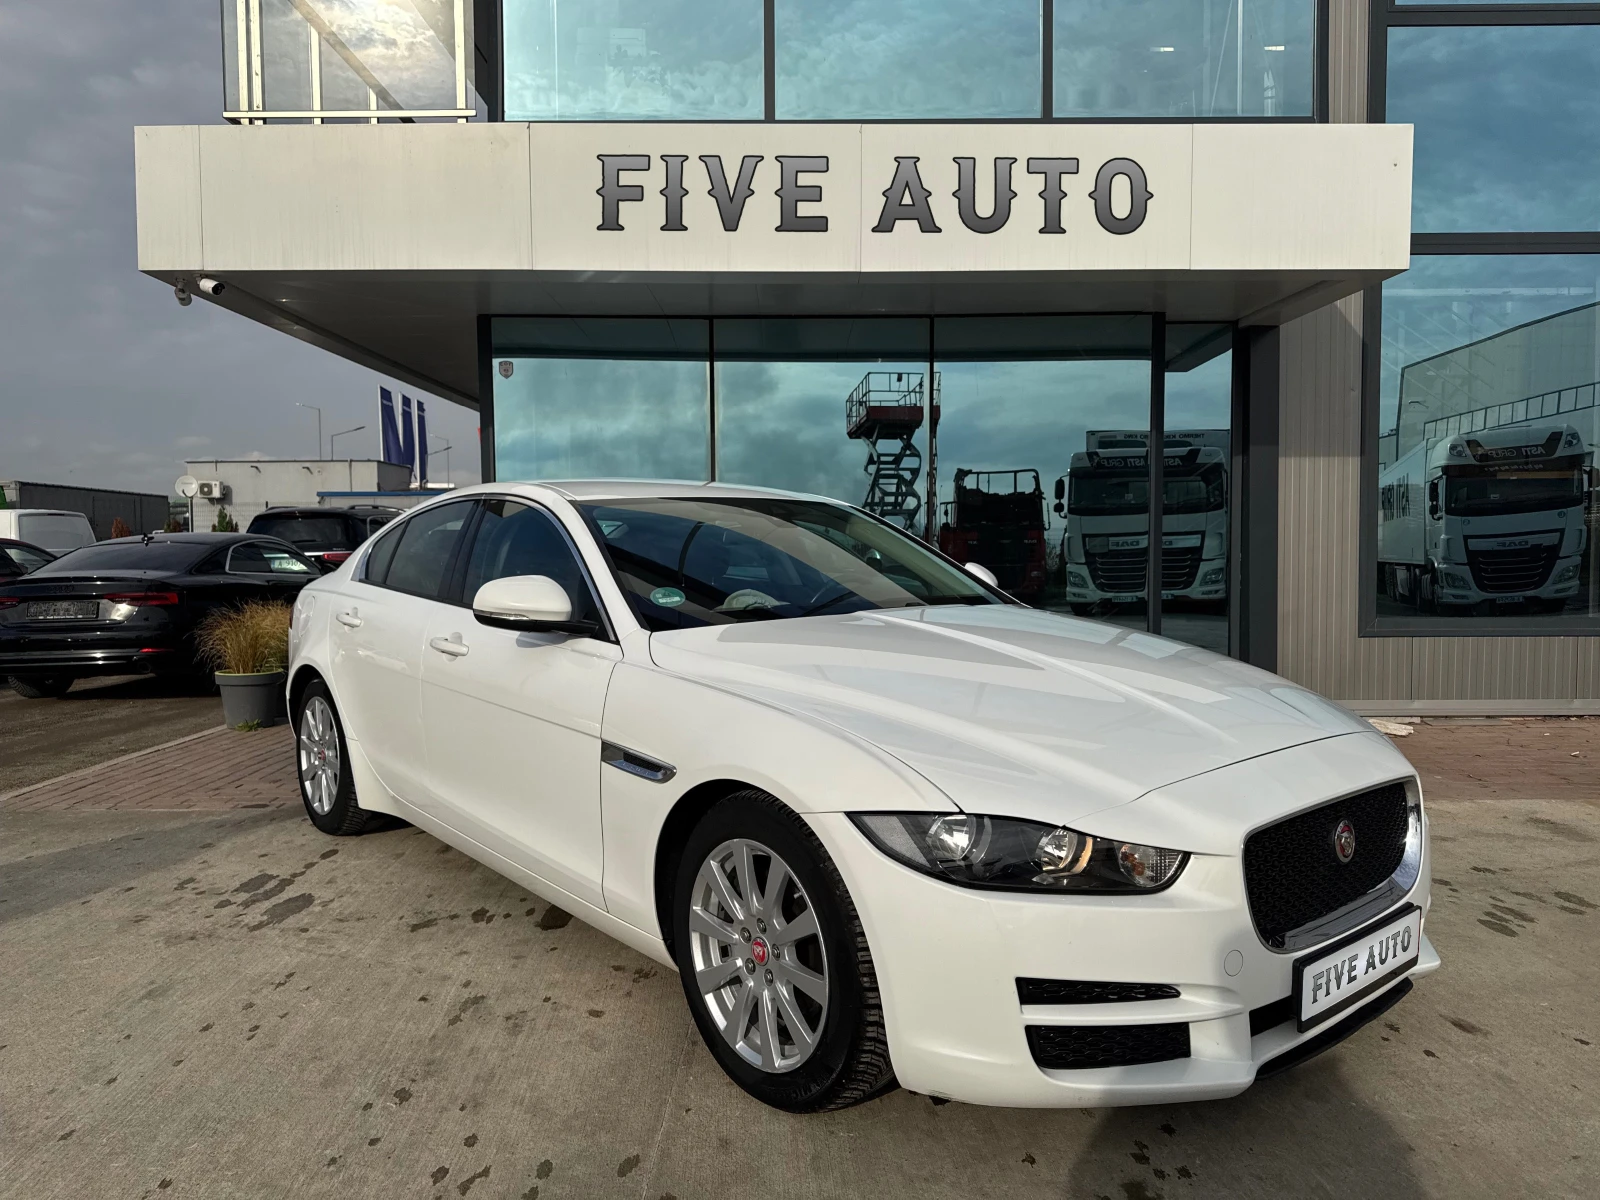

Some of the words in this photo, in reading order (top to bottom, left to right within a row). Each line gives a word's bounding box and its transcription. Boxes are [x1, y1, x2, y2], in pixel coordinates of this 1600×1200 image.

[596, 154, 829, 232] FIVE
[871, 155, 1155, 235] AUTO
[1312, 953, 1359, 1005] FIVE
[1363, 925, 1412, 976] AUTO
